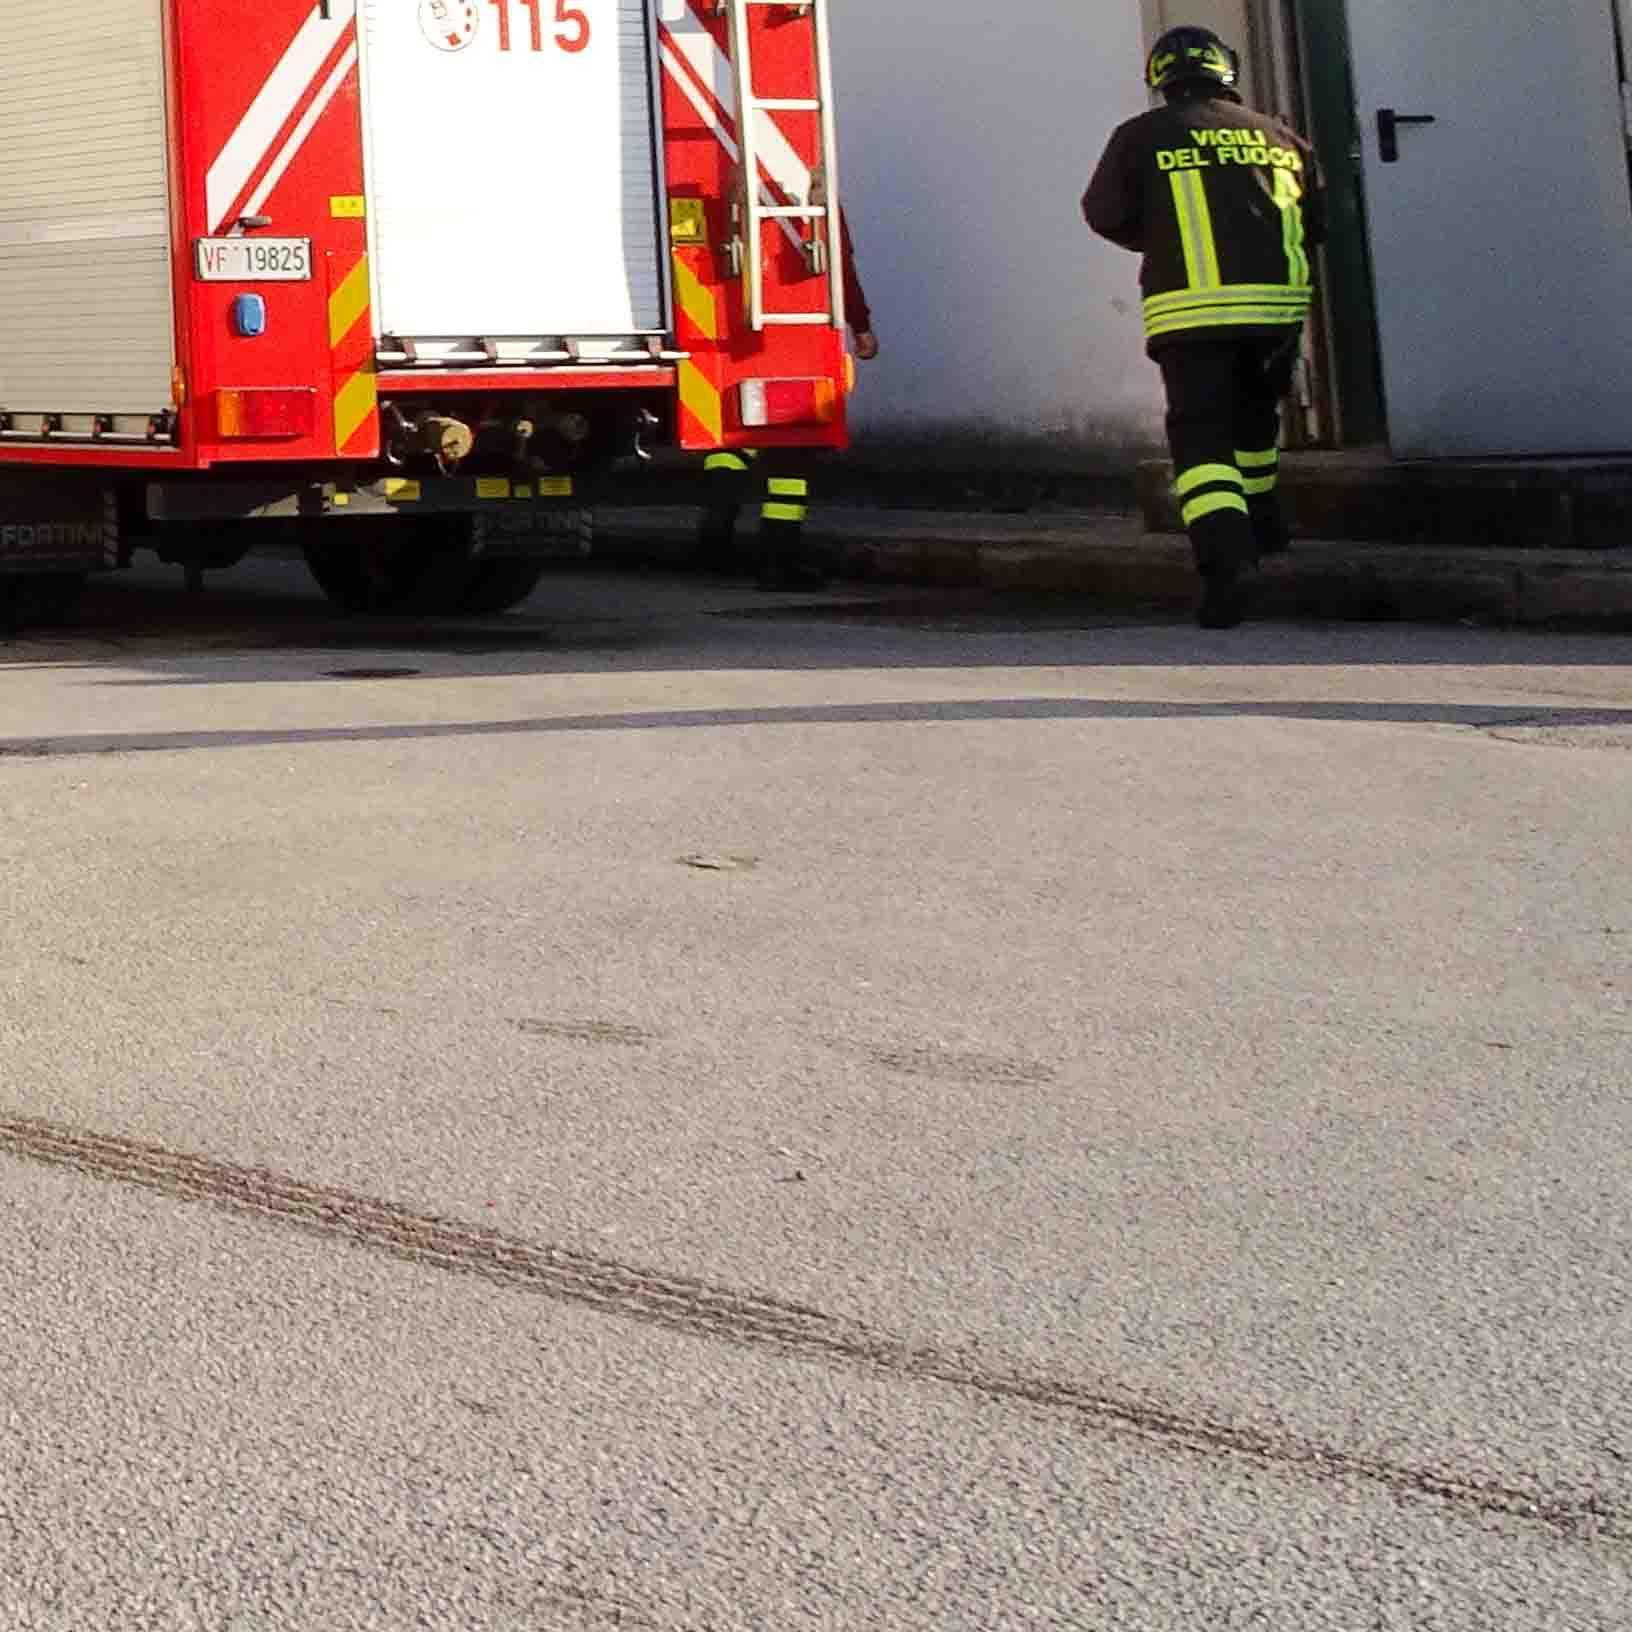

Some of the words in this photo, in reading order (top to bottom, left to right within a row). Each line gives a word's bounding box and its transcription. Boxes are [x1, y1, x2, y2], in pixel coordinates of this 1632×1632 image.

[1190, 128, 1267, 147] VIGILI
[1156, 148, 1210, 170] DEL
[1216, 146, 1303, 172] FUOCO
[203, 246, 227, 272] VF
[245, 246, 305, 272] 19825
